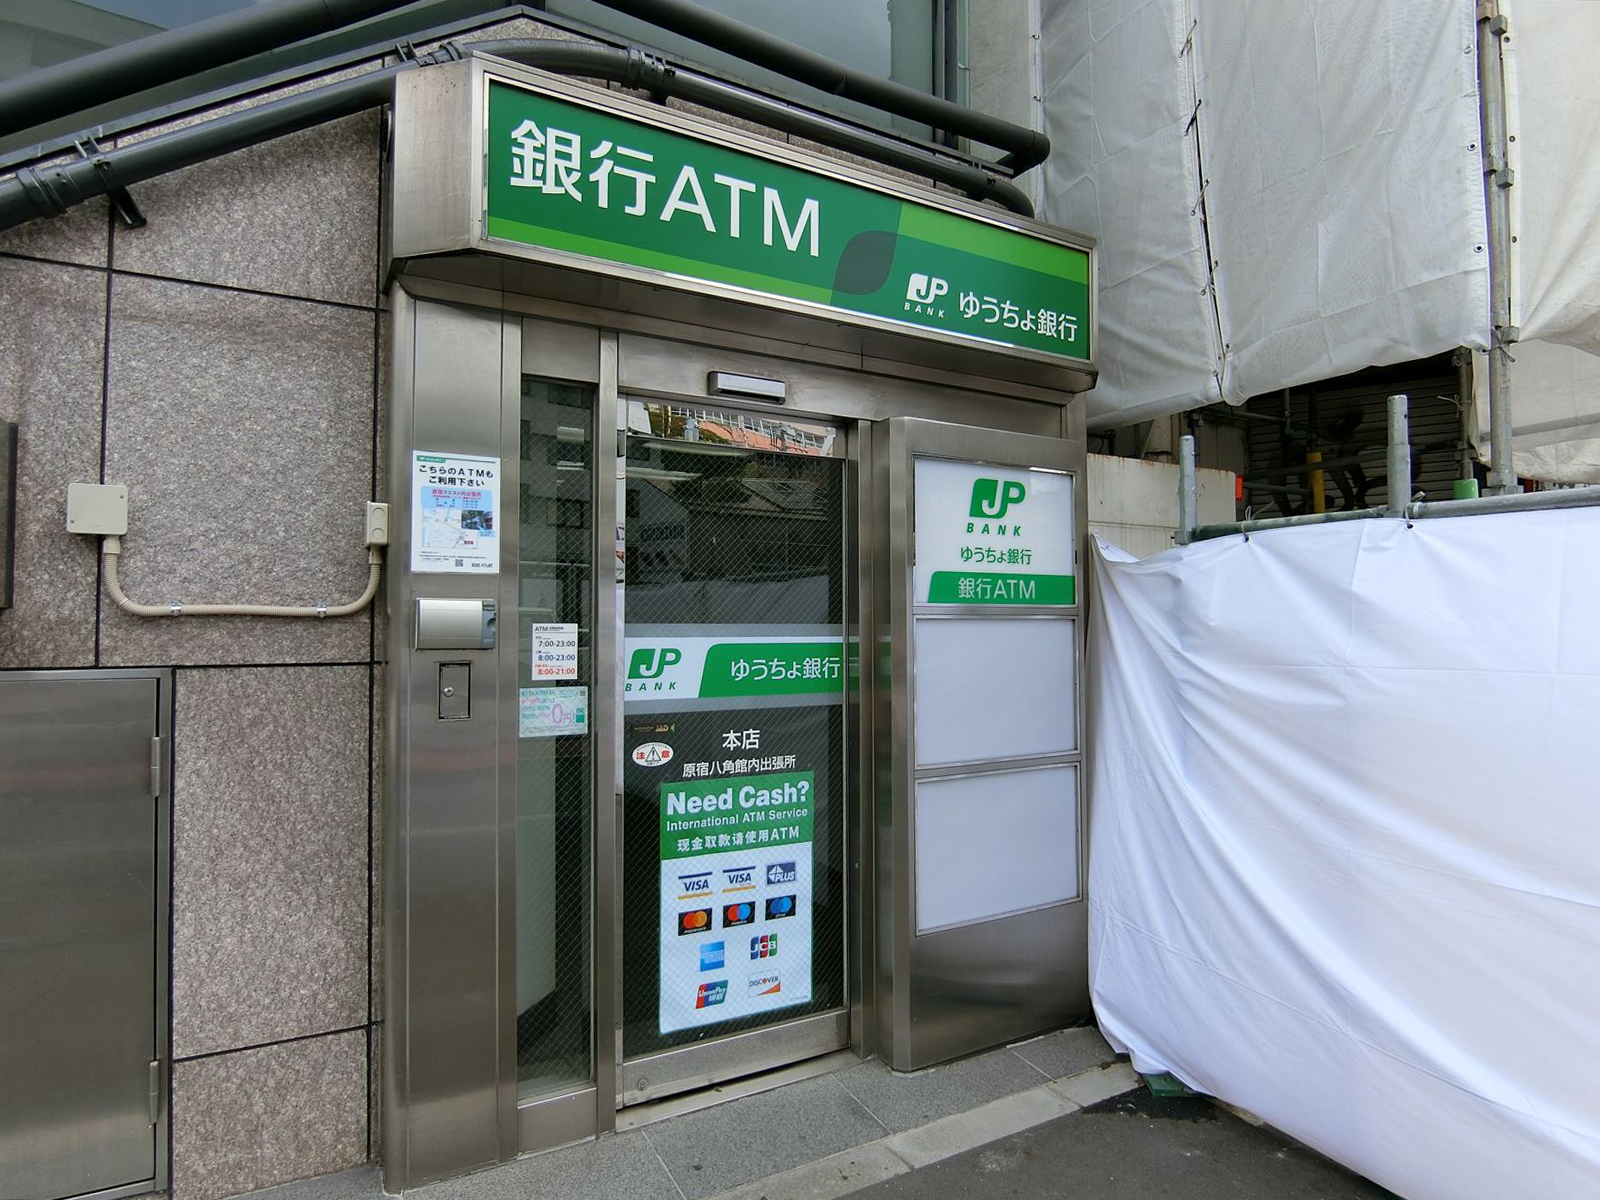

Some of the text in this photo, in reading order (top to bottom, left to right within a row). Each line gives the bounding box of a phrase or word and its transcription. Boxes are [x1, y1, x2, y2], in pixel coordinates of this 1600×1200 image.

[509, 118, 821, 258] 銀行ATM
[906, 272, 949, 305] JP
[903, 302, 946, 318] BANK
[957, 290, 1078, 343] ゆうちょ銀行
[428, 475, 486, 487] ご利用下さい
[969, 478, 1026, 519] JP
[967, 522, 1022, 536] BANK
[960, 546, 1032, 565] ゆうちょ銀行
[958, 577, 1036, 600] 銀行ATM
[538, 640, 576, 648] 7:00-23:00
[628, 648, 682, 679] JP
[730, 657, 840, 682] ゆうちょ銀行
[625, 681, 677, 692] BANK
[722, 729, 760, 751] 本店
[682, 755, 797, 778] 原宿八角館内出張所
[666, 781, 810, 816] Need Cash?
[666, 808, 809, 832] International ATM Service
[676, 826, 800, 853] 现金取款请使用ATM
[684, 879, 710, 892] VISA
[728, 873, 752, 885] VISA
[775, 871, 795, 883] PLUS
[750, 937, 777, 957] JCB
[749, 976, 779, 987] DISCOVER
